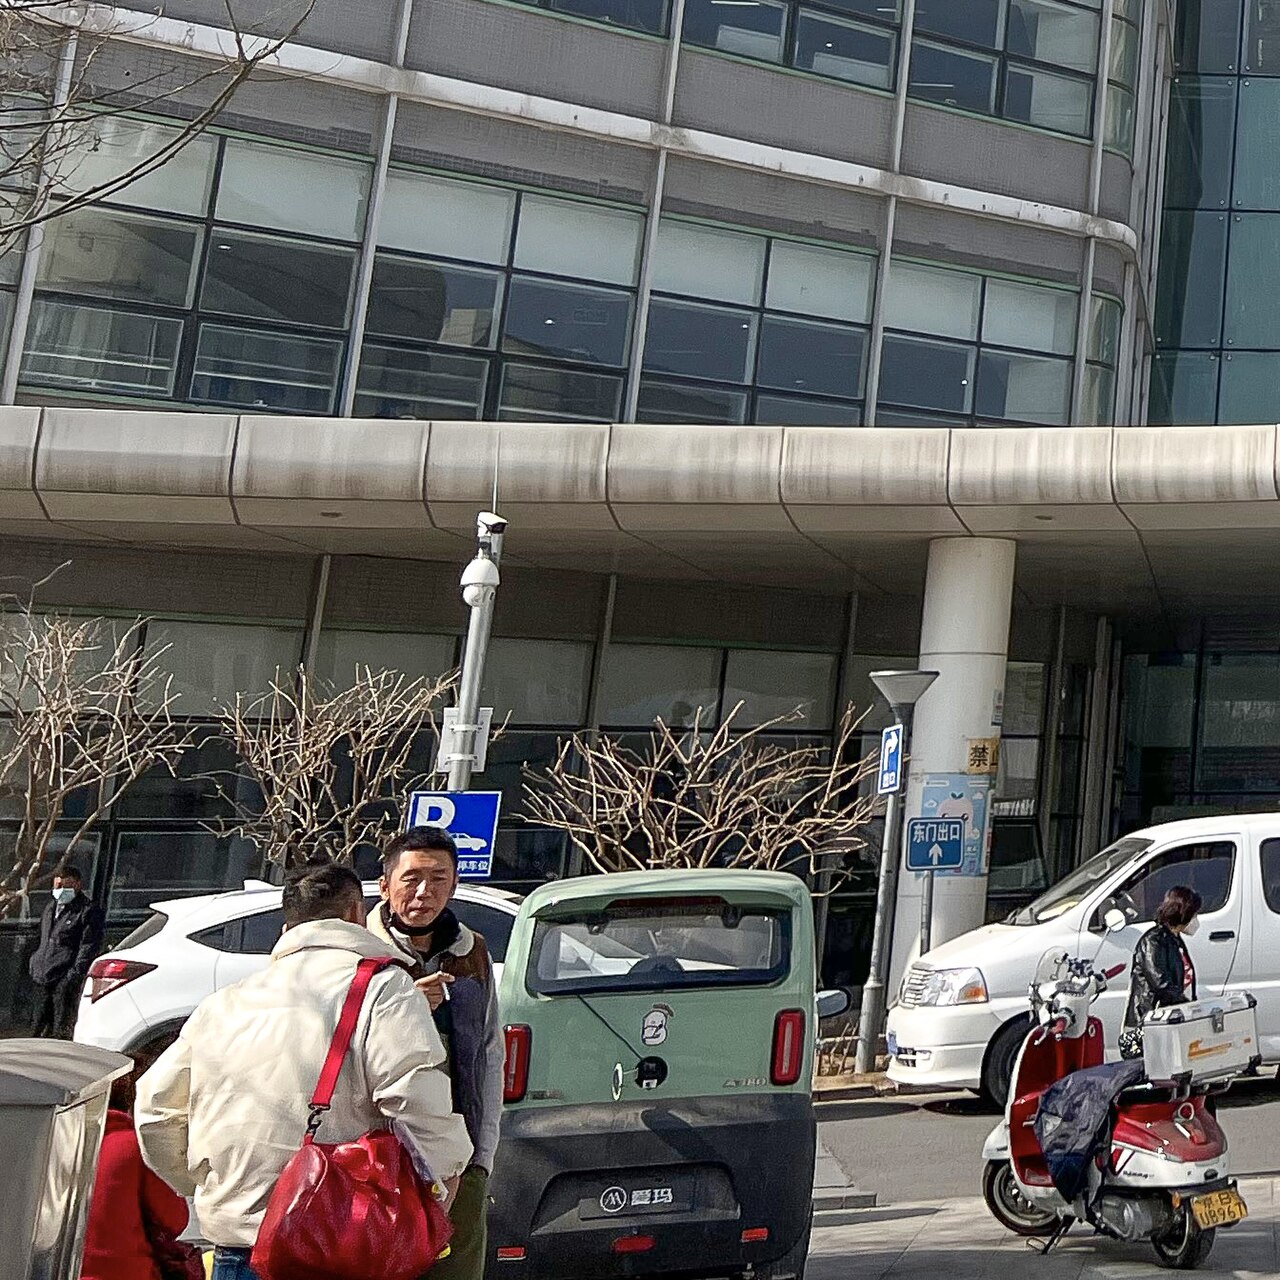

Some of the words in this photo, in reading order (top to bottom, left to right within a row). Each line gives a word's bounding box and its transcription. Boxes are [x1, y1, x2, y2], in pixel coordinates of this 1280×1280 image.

[912, 822, 960, 844] 东门出口
[631, 1187, 673, 1206] 爱玛
